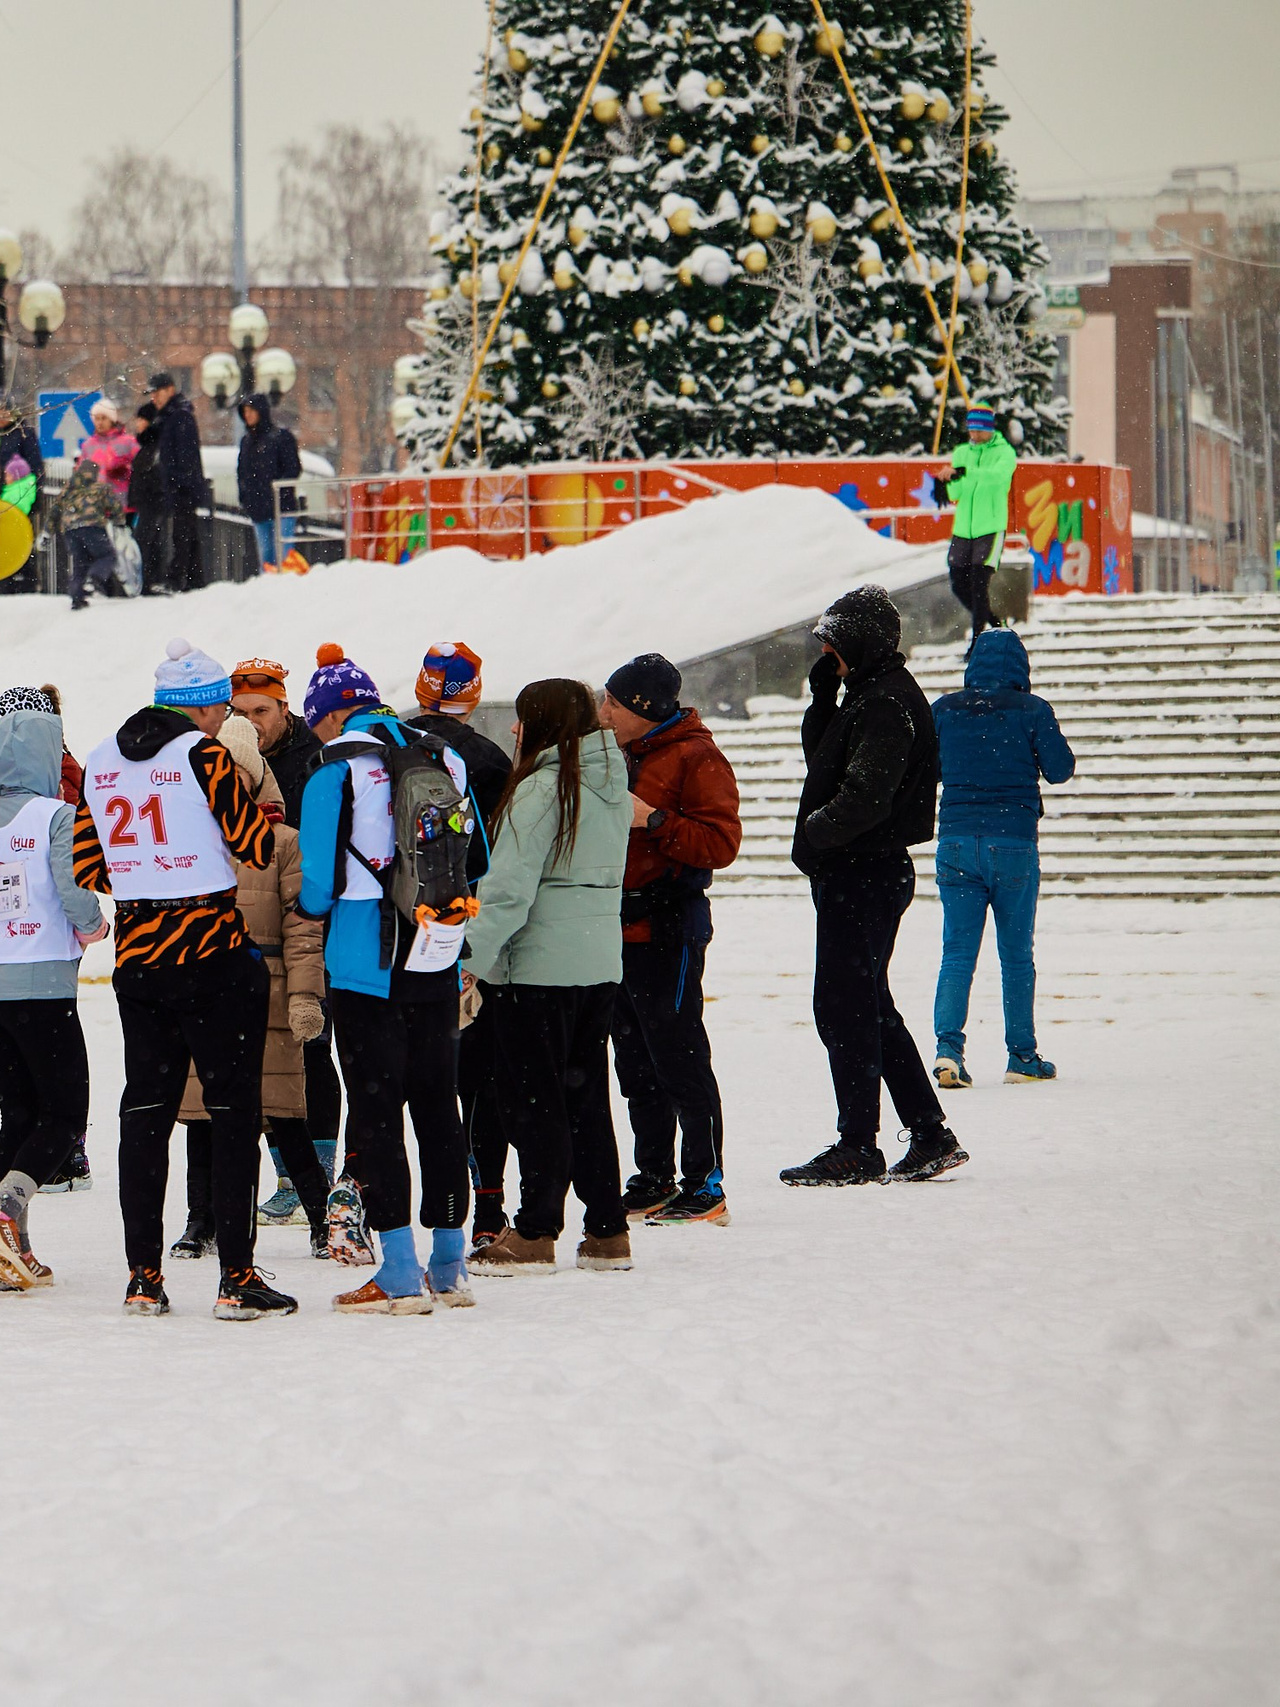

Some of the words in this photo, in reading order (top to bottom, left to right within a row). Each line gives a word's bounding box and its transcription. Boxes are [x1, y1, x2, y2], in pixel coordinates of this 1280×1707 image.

[155, 771, 182, 783] НЦВ
[105, 793, 168, 848] 21
[13, 838, 36, 850] НЦВ
